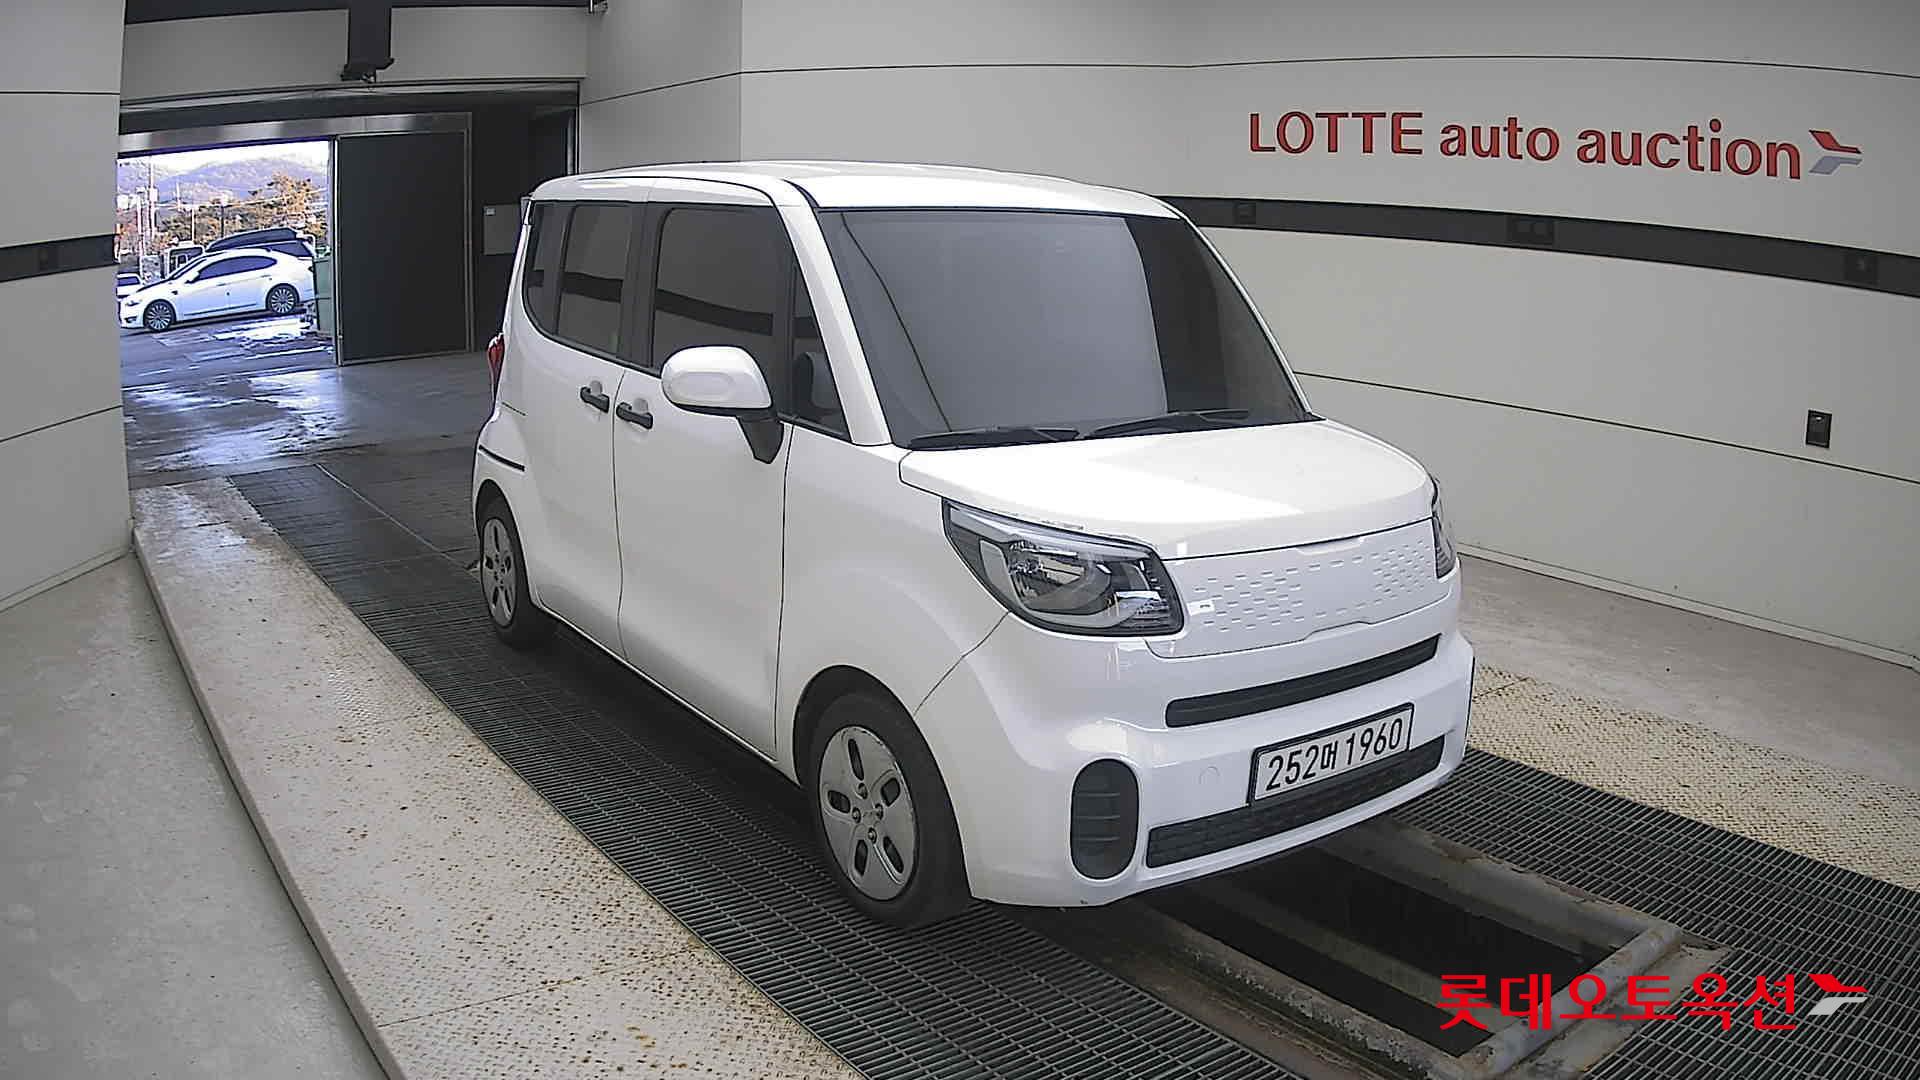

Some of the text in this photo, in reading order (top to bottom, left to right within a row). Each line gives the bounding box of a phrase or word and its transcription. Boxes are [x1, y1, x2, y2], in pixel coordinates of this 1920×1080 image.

[1249, 111, 1802, 180] LOTTE auto auction
[1265, 718, 1403, 791] 252머 1960
